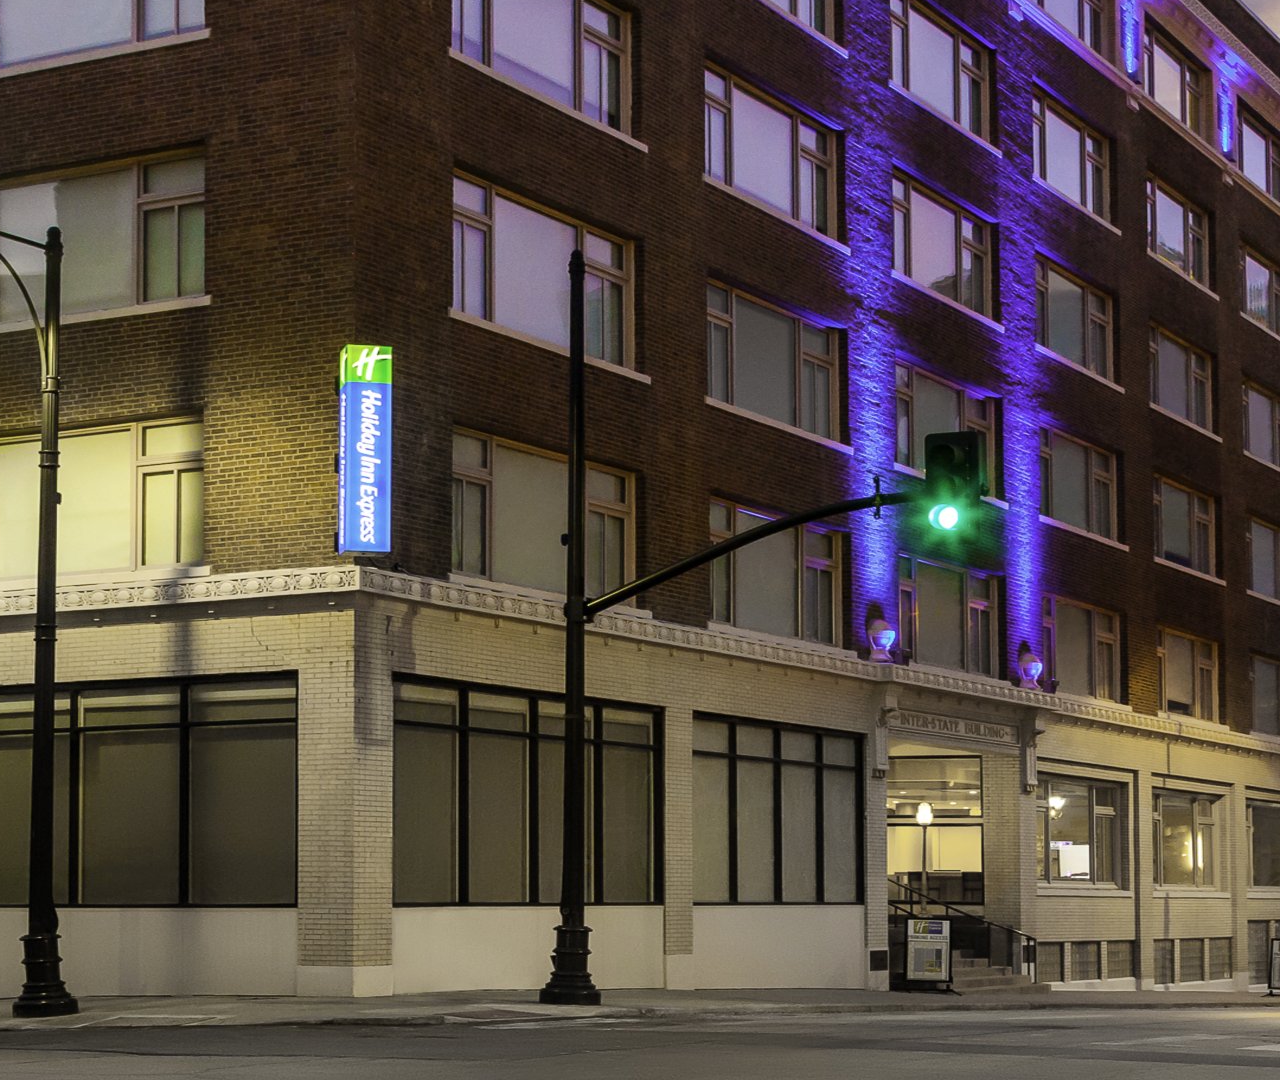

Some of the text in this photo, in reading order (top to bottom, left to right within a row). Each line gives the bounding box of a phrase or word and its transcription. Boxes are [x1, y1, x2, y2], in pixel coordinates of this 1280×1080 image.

[355, 389, 382, 544] Holiday Inn Express
[900, 712, 1005, 739] INTER-STATE BUILDING
